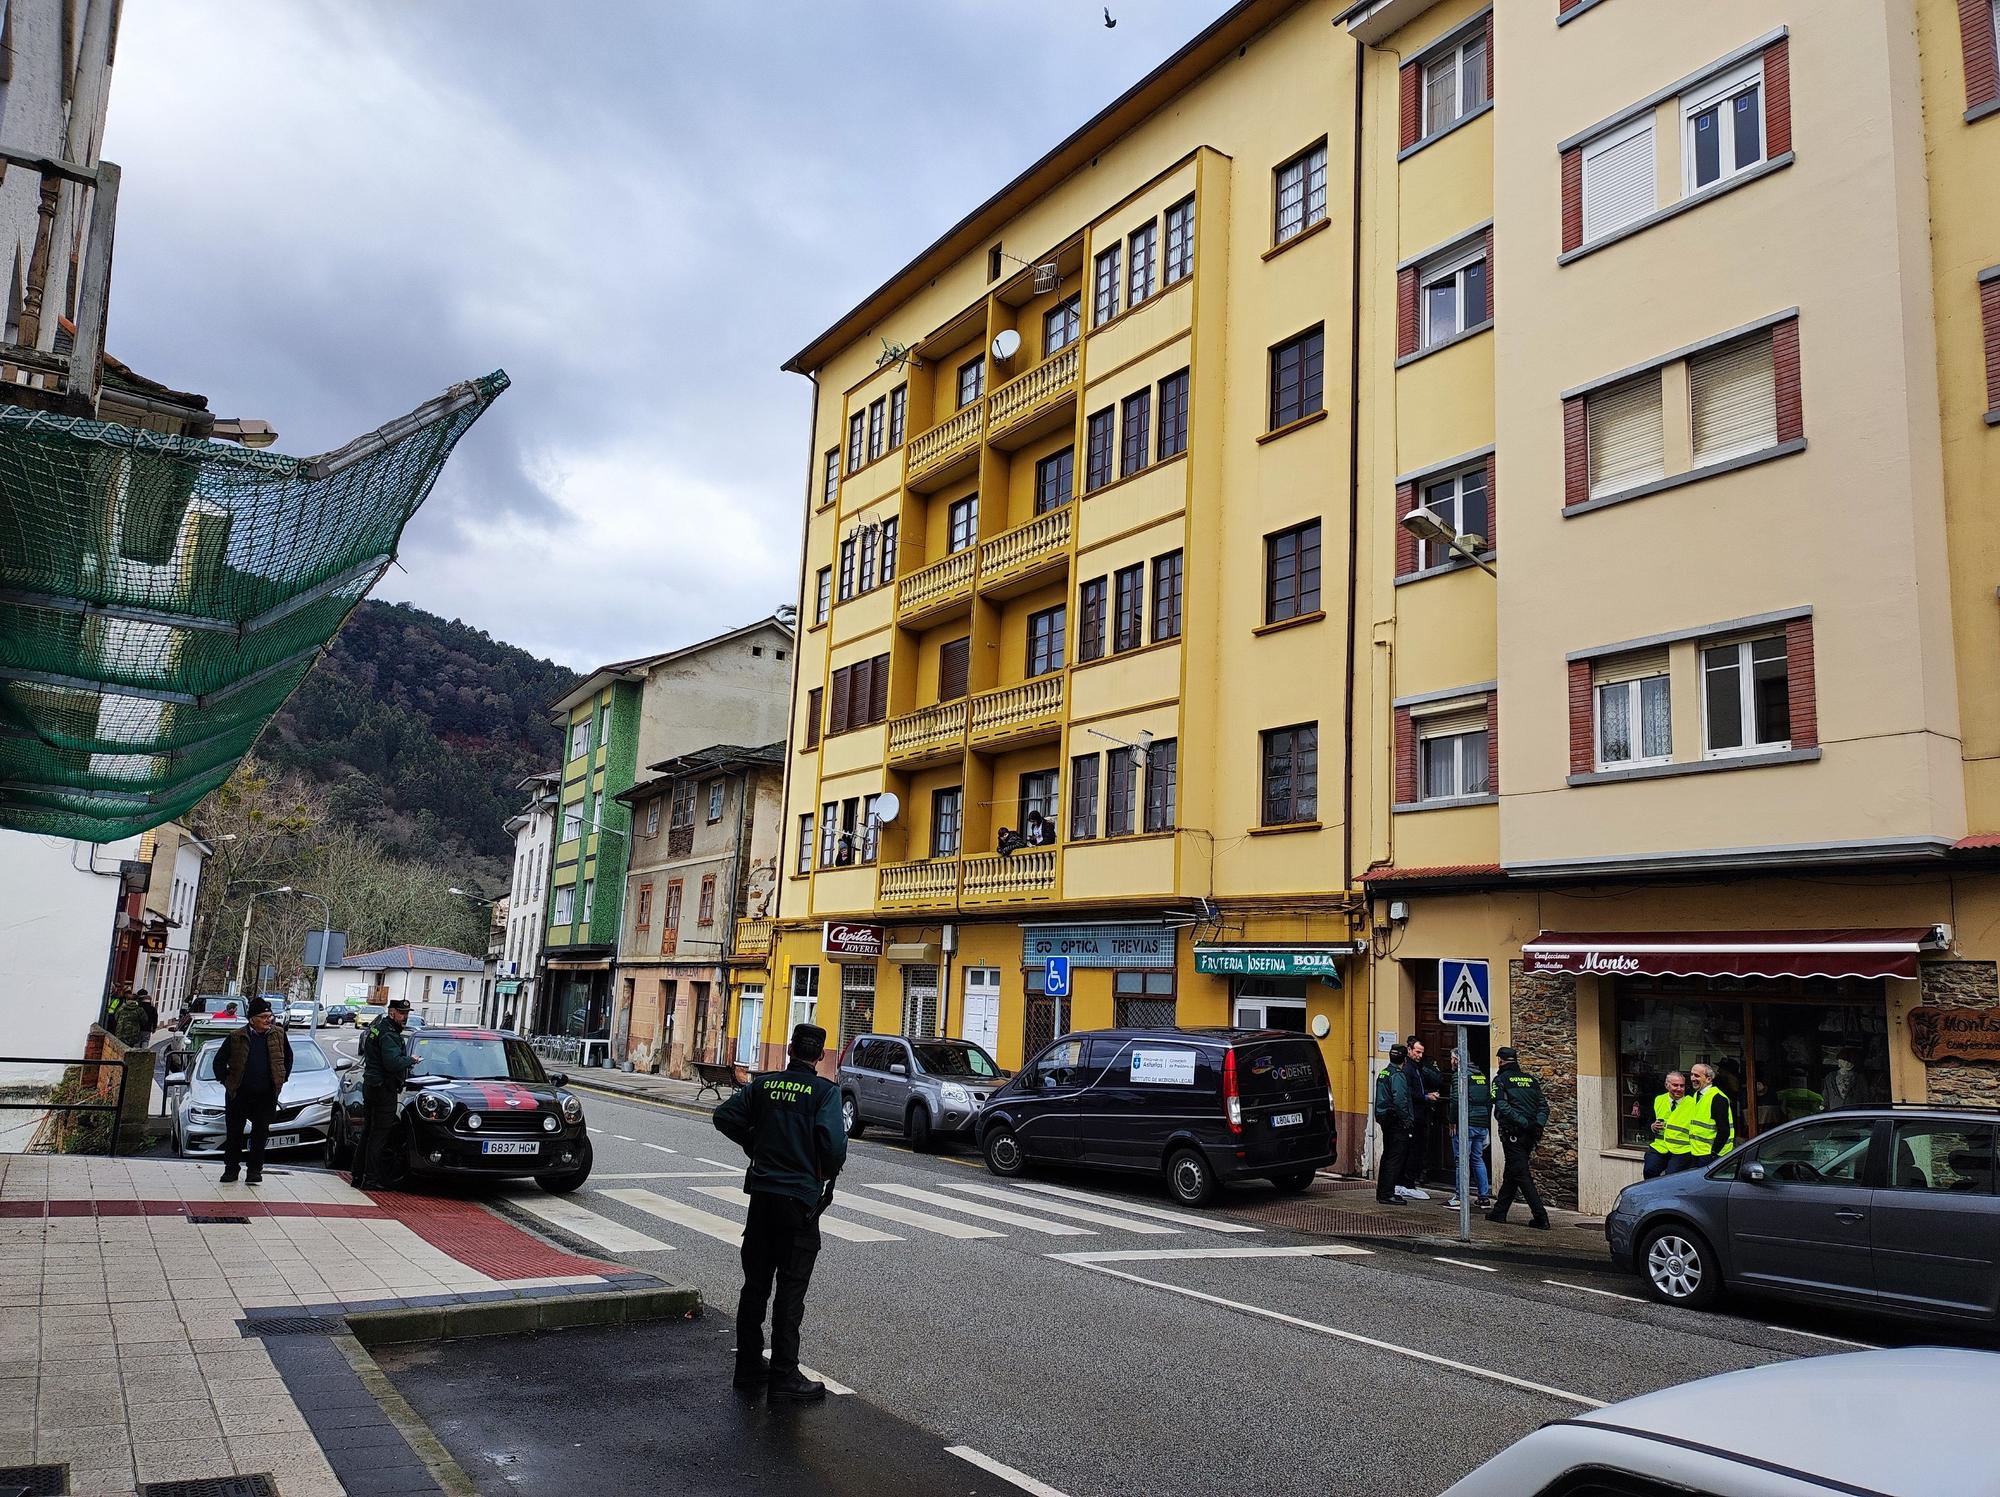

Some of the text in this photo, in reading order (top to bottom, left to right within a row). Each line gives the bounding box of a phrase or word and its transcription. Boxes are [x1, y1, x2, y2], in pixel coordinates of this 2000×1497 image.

[845, 944, 878, 953] JOYERIA
[1060, 939, 1159, 954] OPTICA TREVIAS
[1579, 952, 1640, 970] Montse
[763, 1080, 812, 1095] GUARDIA
[770, 1090, 797, 1102] CIVIL
[490, 1143, 516, 1153] 6837
